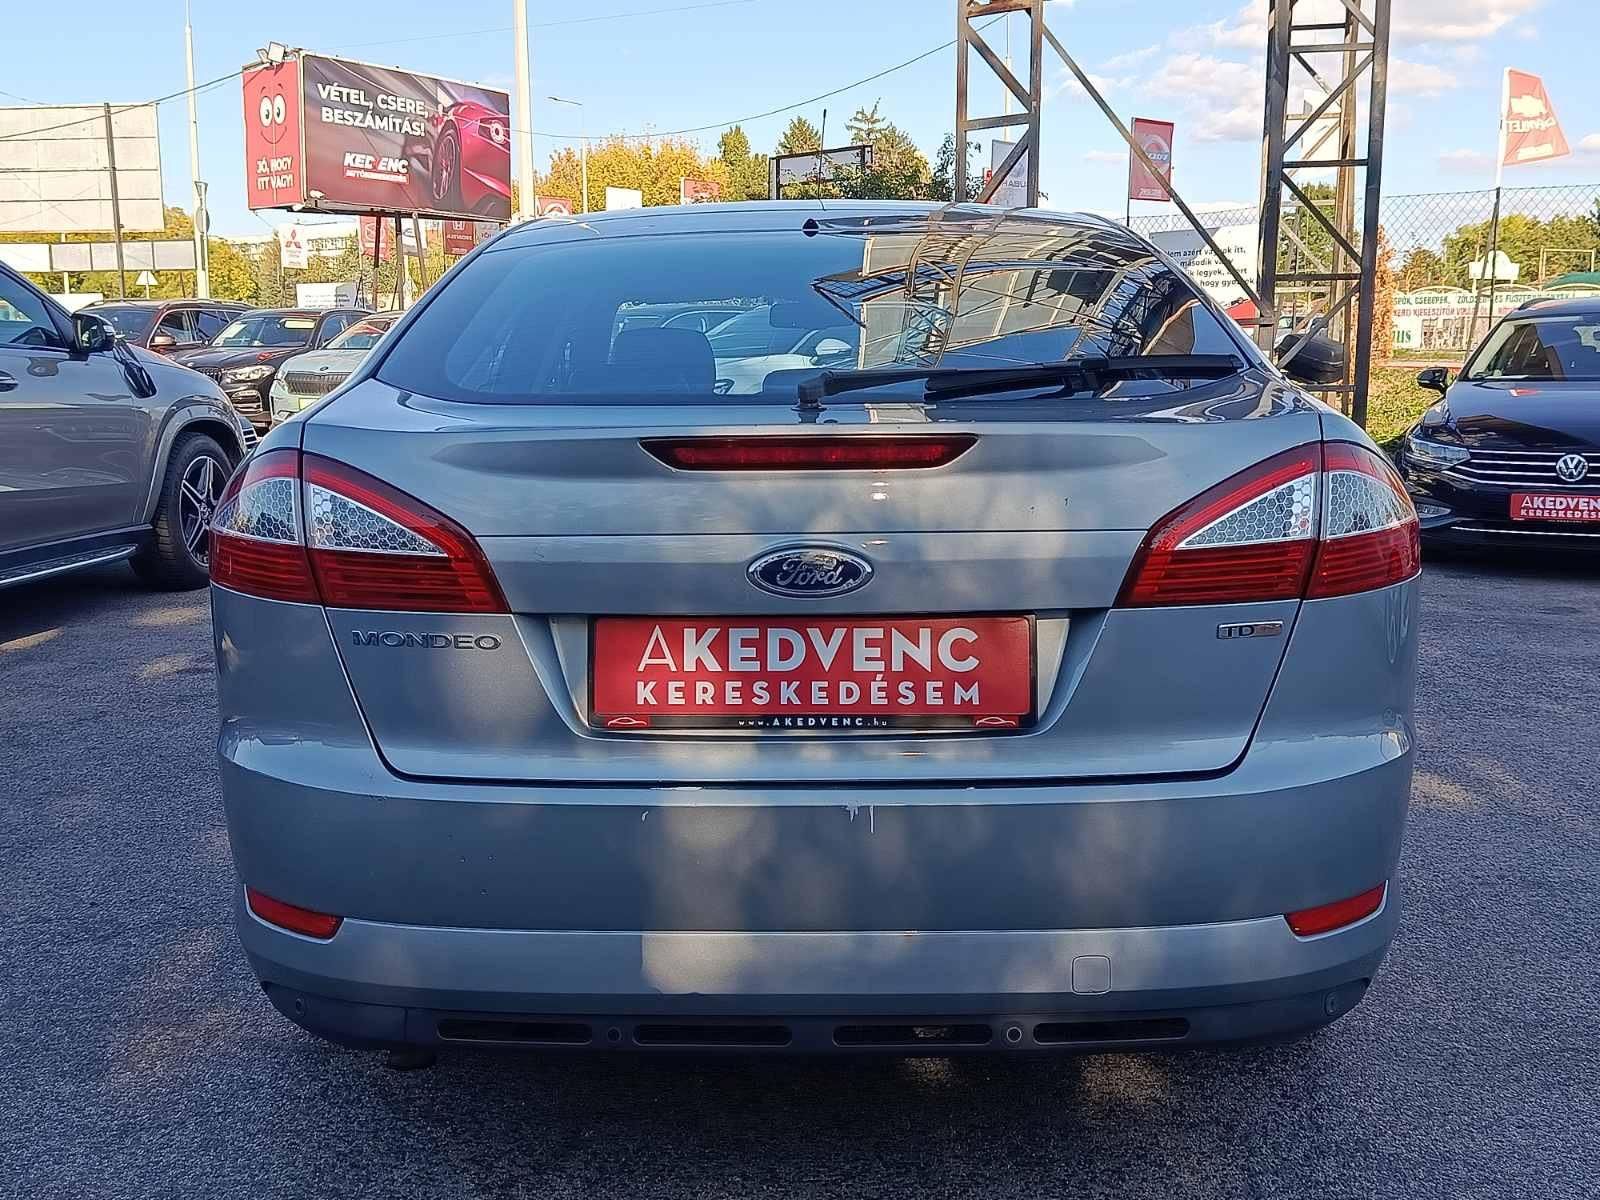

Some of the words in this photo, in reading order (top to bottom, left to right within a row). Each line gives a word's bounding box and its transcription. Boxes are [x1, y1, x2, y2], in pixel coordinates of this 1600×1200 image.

[317, 82, 374, 110] VÉTEL,
[376, 94, 429, 119] CSERE,
[321, 106, 426, 137] BESZÁMÍTÁS!
[270, 156, 293, 172] HOGY
[1204, 246, 1232, 256] vaok
[776, 558, 845, 586] Ford
[351, 630, 503, 651] MONDEO
[636, 624, 980, 673] AKEDVENC
[636, 674, 980, 706] KERESKEDÉSEM
[738, 716, 888, 728] www.AKEDVENC.hu
